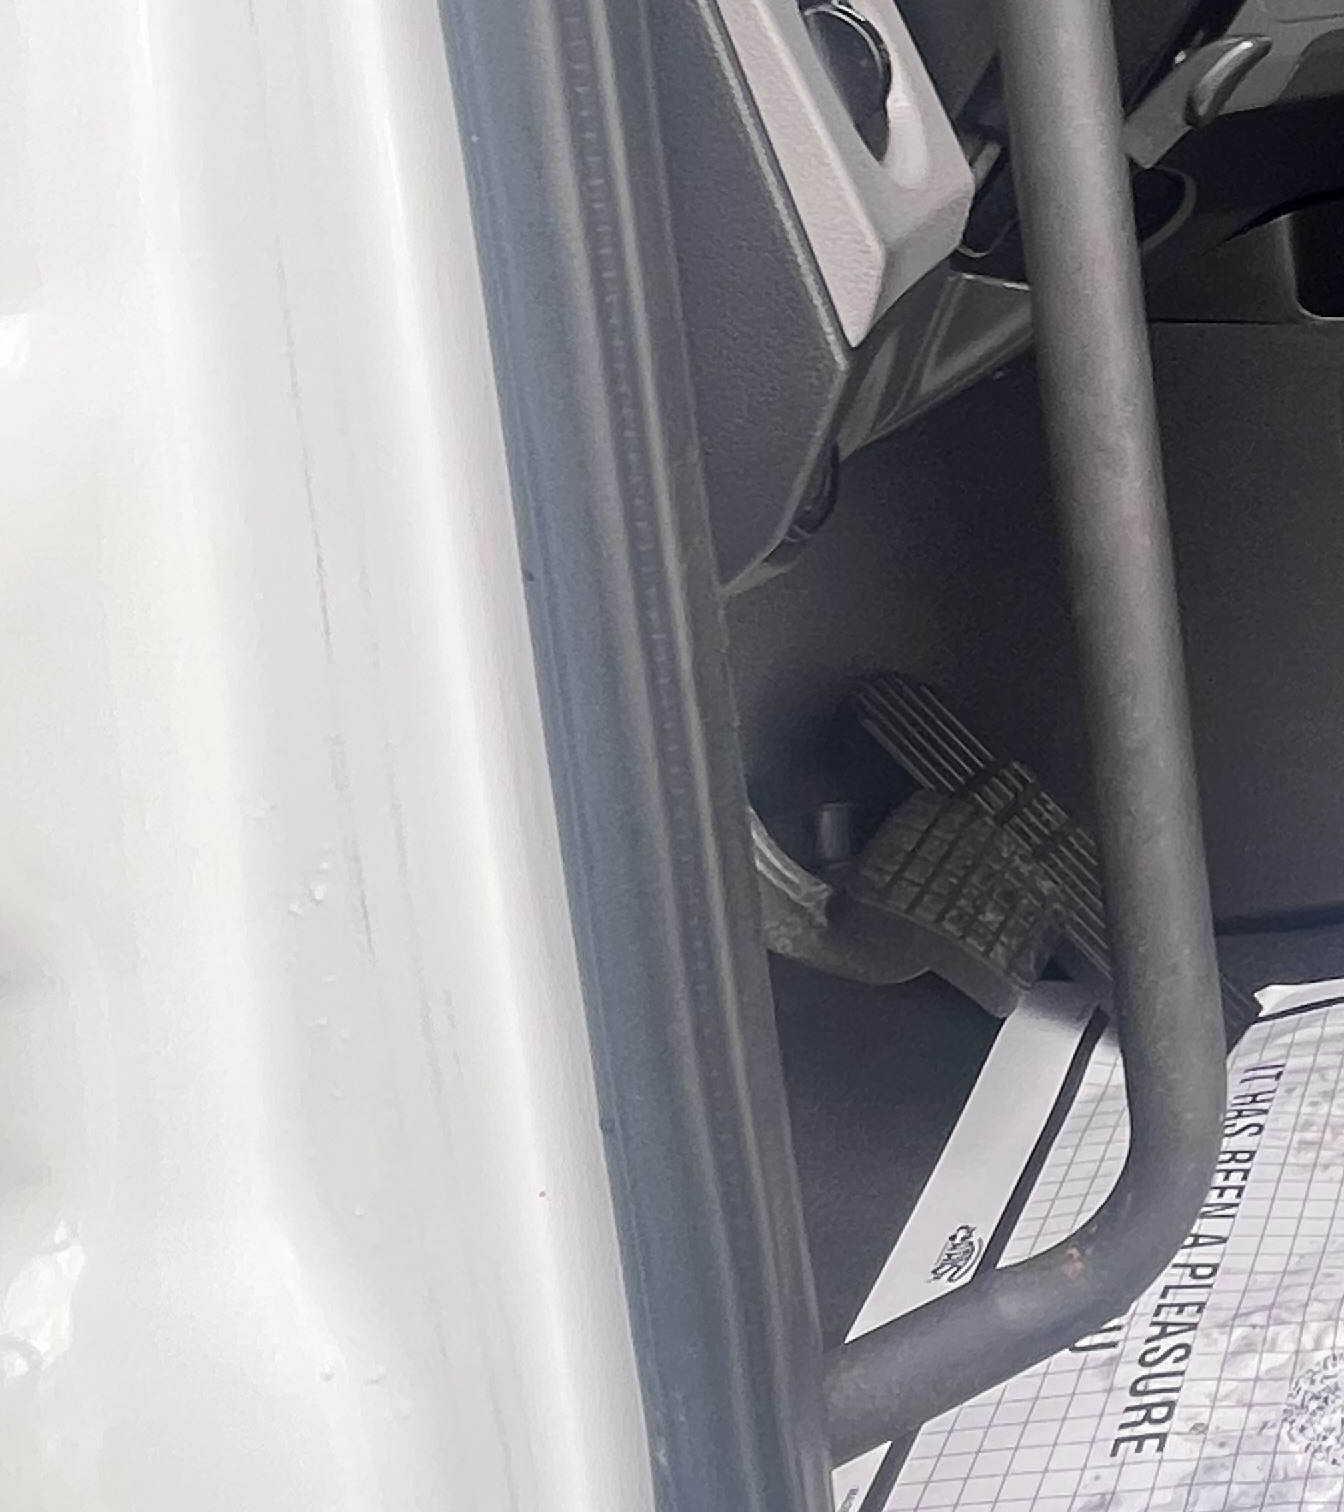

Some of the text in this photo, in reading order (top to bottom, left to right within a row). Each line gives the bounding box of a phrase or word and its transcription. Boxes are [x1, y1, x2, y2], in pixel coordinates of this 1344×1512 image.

[1240, 1062, 1285, 1084] IT
[1225, 1089, 1277, 1138] HAS
[1182, 1233, 1228, 1249] A
[1109, 1261, 1220, 1458] PLEASURE
